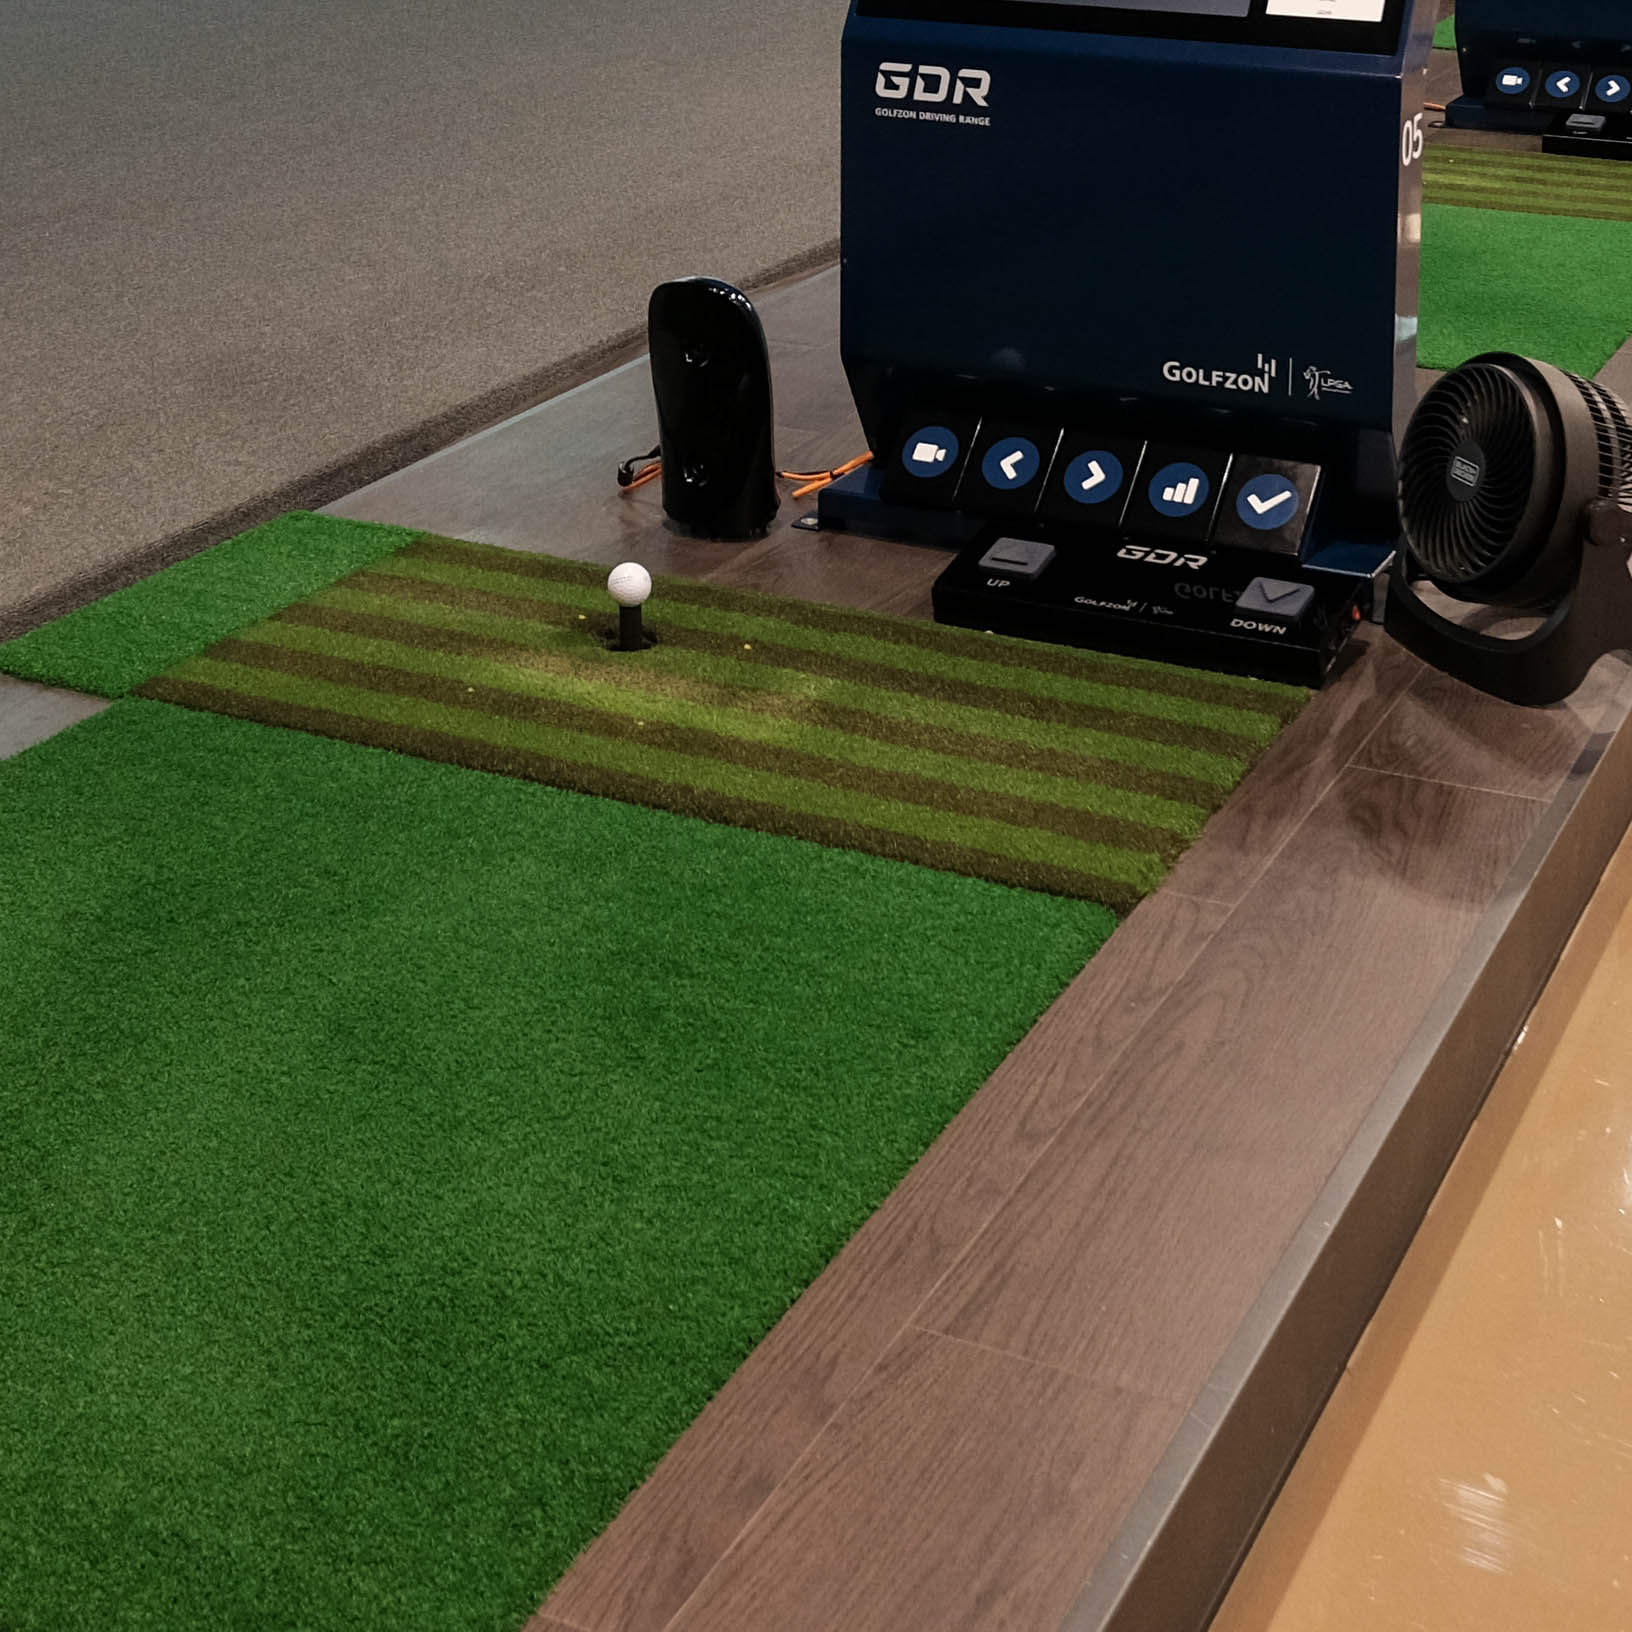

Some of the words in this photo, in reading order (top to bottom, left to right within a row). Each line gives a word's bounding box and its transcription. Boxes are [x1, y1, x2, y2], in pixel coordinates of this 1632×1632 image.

[875, 62, 991, 107] GDR
[875, 107, 917, 120] GOLFZON
[919, 111, 956, 124] DRIVING
[958, 115, 991, 126] RANGE
[1402, 112, 1424, 166] 05
[1163, 360, 1269, 394] GOLFZON
[1321, 376, 1353, 390] LPGA
[1117, 545, 1208, 570] GDR
[986, 578, 1010, 588] UP
[1074, 596, 1131, 612] GOLFZON
[1230, 617, 1287, 635] DOWN
